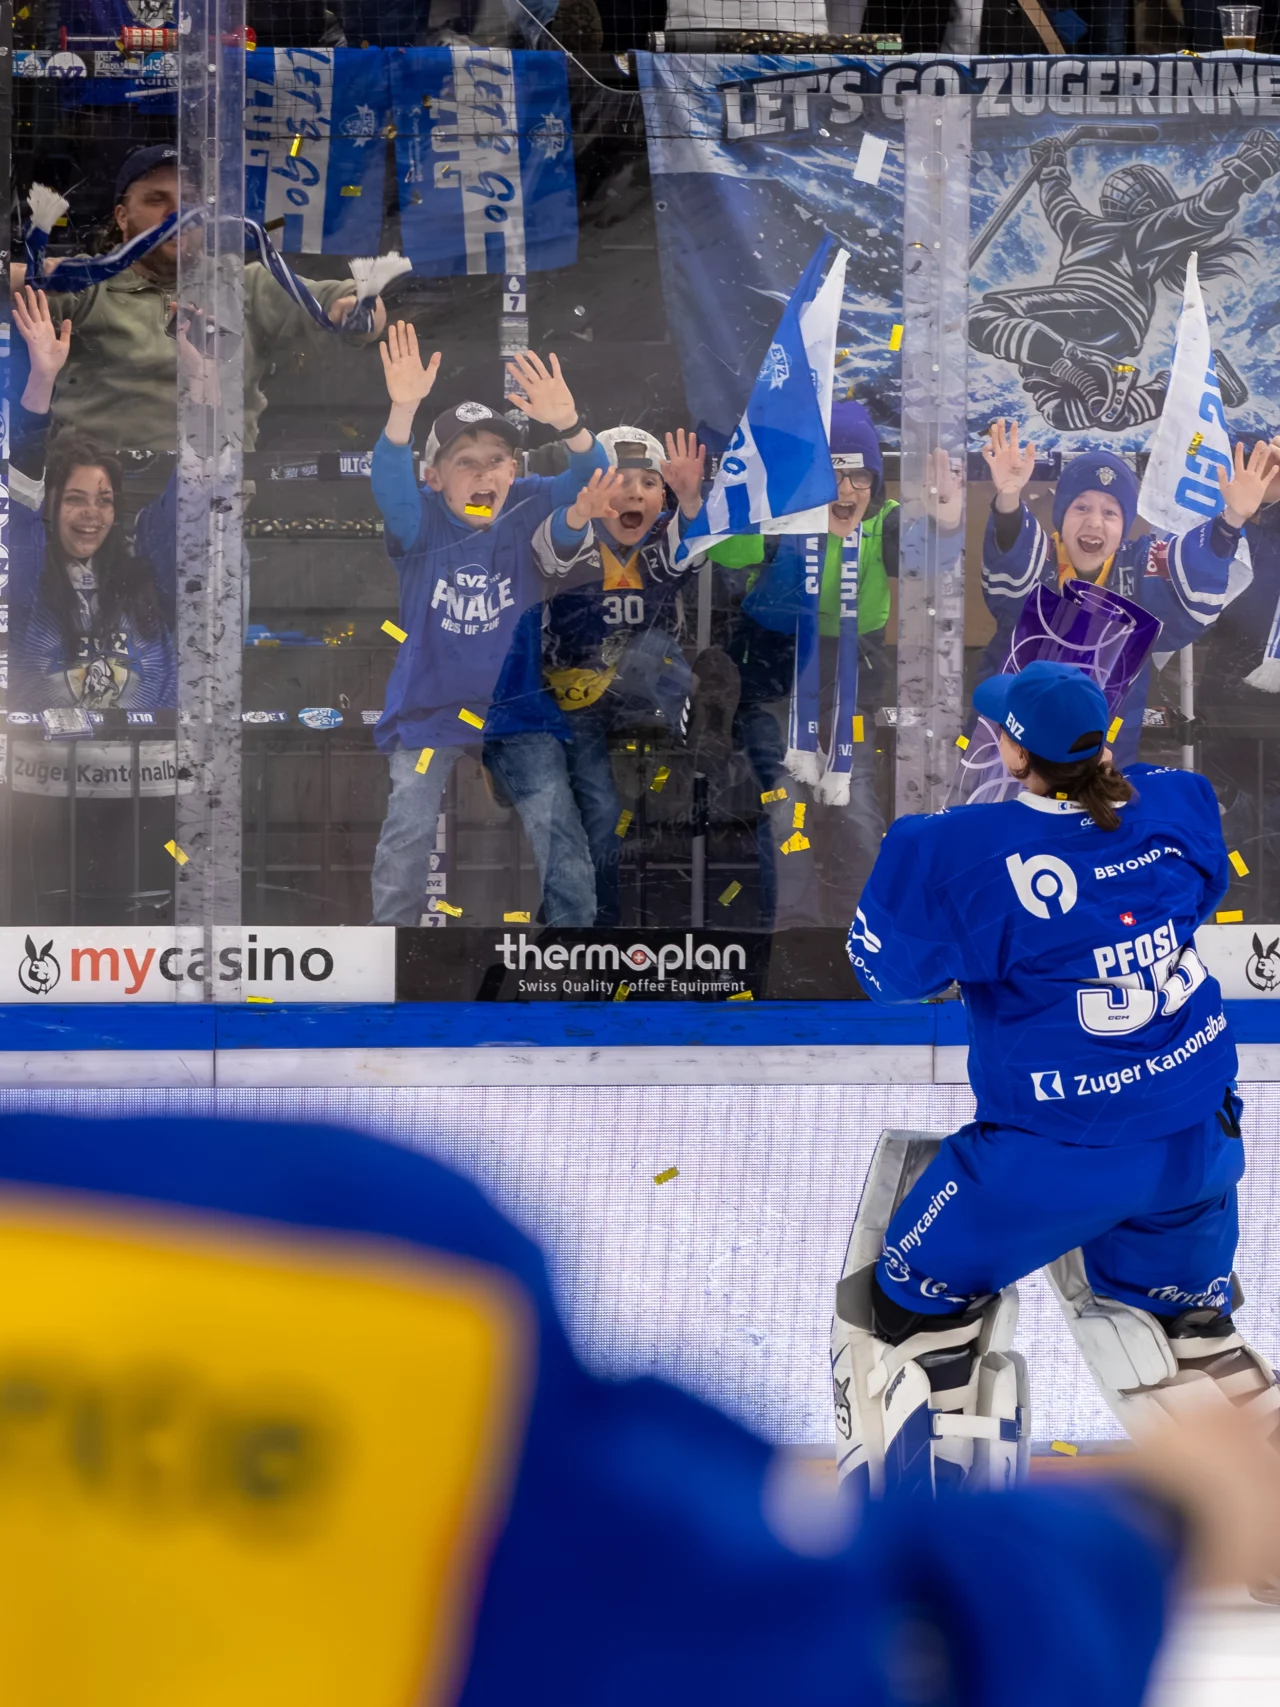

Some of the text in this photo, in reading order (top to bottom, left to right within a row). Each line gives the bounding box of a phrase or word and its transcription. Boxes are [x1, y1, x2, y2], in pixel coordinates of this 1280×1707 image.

[724, 70, 864, 139] LET'S
[880, 64, 961, 120] GO
[509, 296, 520, 311] 7
[456, 573, 488, 588] EVZ
[603, 596, 644, 625] 30
[1005, 711, 1026, 741] EVZ
[14, 756, 69, 785] Zuger
[77, 759, 176, 784] Kantnalb
[1093, 848, 1162, 880] BEYOND
[70, 934, 334, 994] mycasino
[494, 933, 747, 981] thermoplan
[518, 979, 746, 995] Swiss Quality Coffee Equipment
[1073, 1063, 1142, 1097] Zuger
[898, 1180, 959, 1254] mycasino
